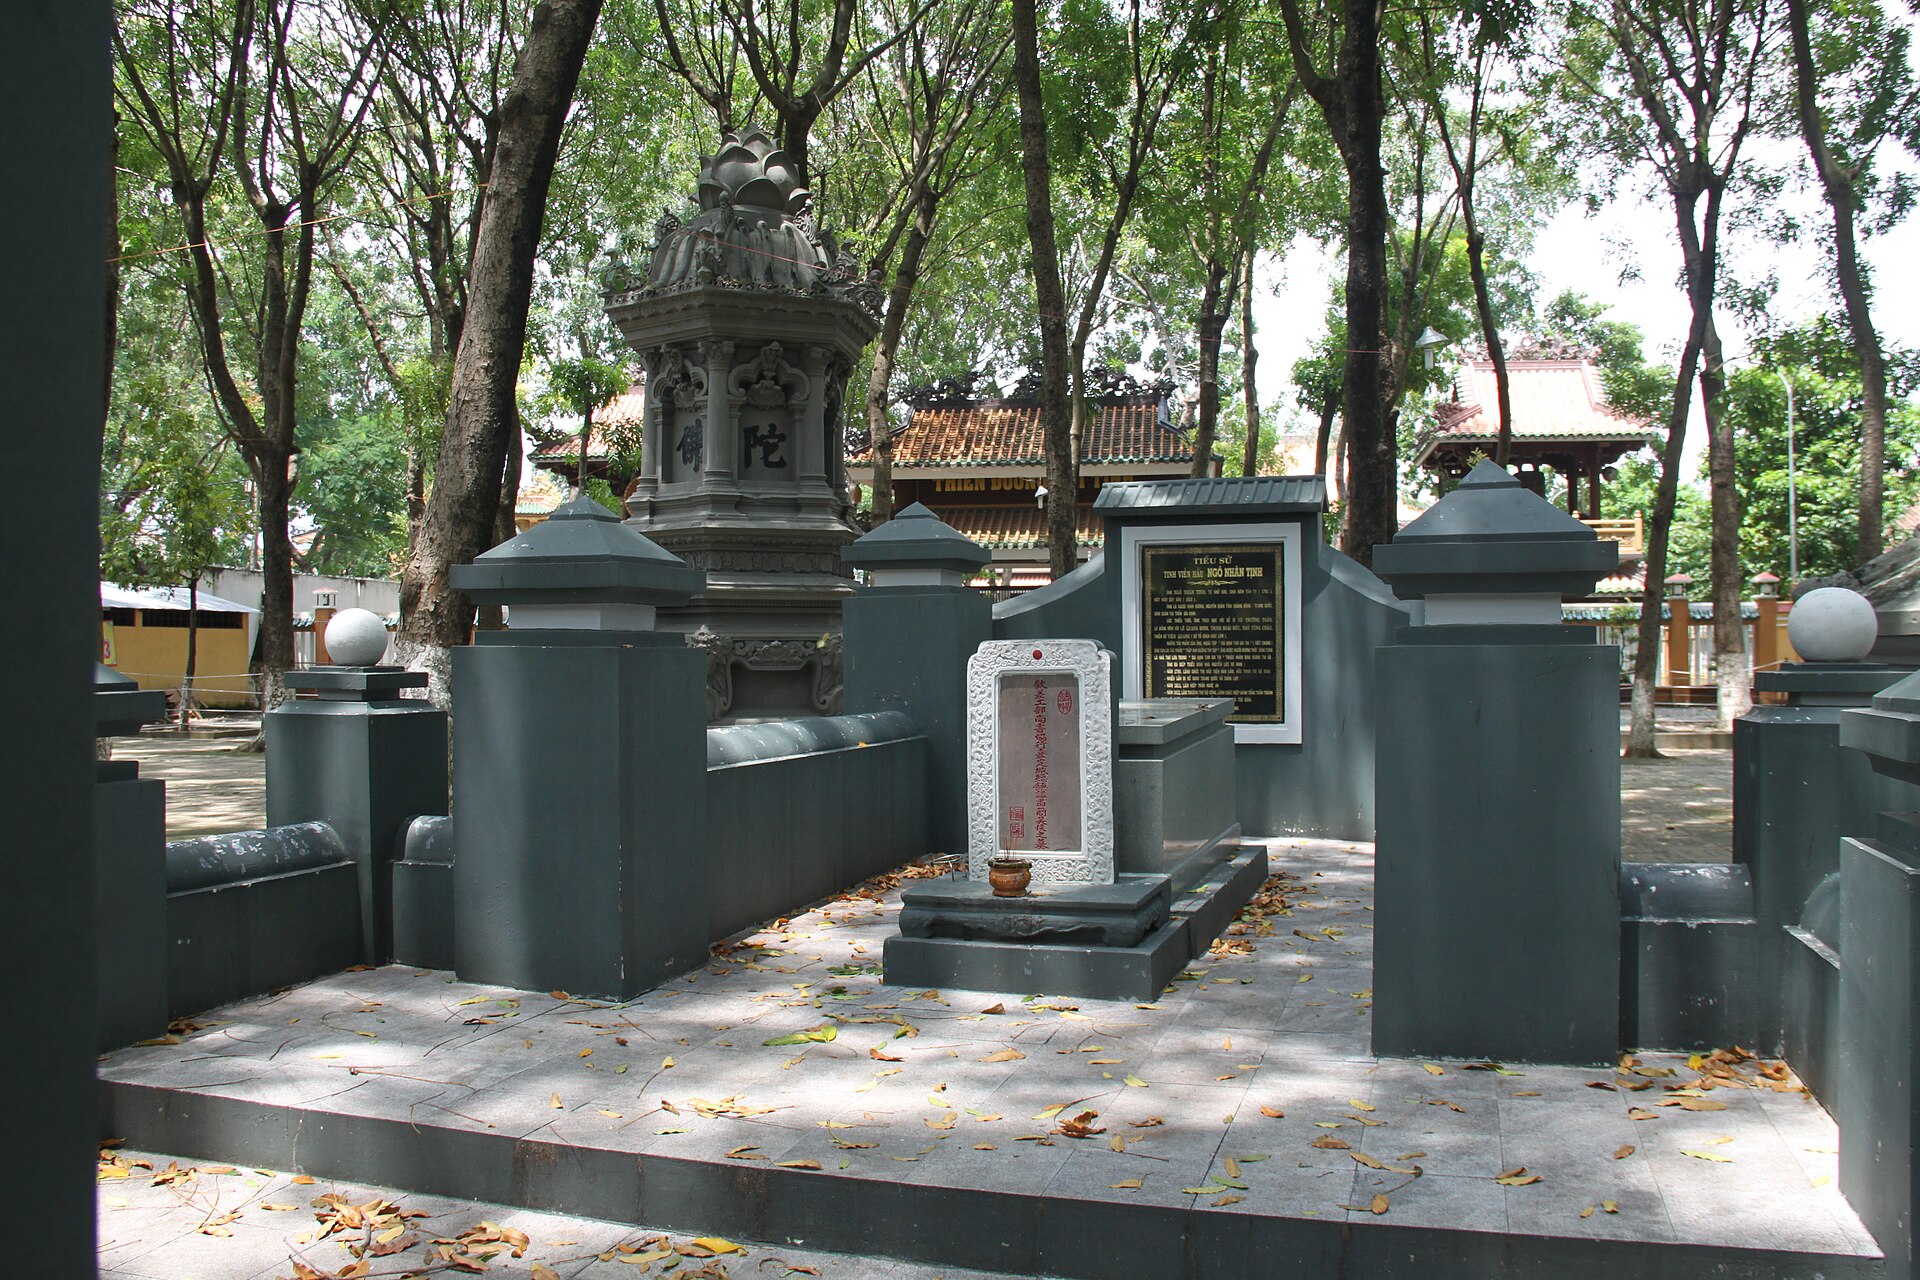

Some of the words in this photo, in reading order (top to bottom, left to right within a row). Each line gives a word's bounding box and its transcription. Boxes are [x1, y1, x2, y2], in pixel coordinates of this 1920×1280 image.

[743, 423, 787, 469] 陀
[1207, 565, 1223, 578] NGÔ
[1224, 565, 1244, 578] NHÂN
